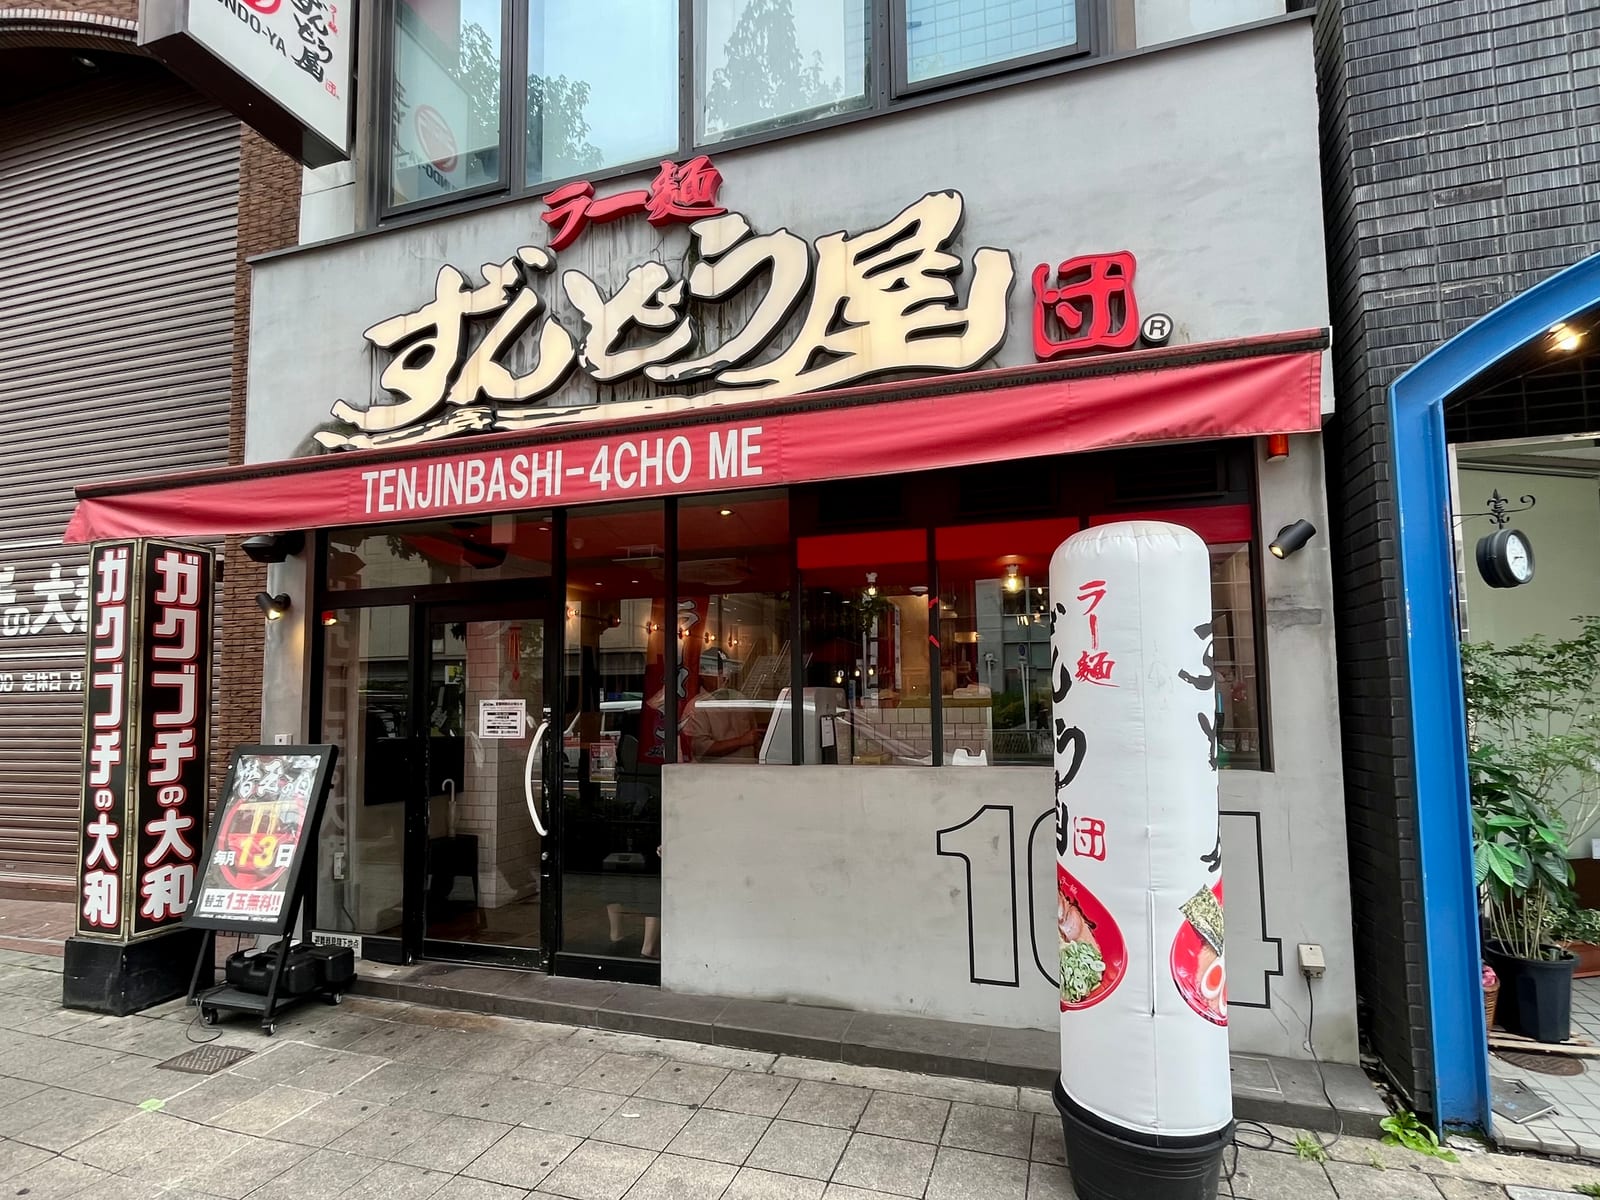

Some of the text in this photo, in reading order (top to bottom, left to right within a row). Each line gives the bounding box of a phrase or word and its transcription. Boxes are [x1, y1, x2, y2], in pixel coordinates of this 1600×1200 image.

[540, 155, 728, 253] ラー麺
[325, 189, 1015, 440] ずんどう屋
[1032, 249, 1141, 362] 団
[362, 426, 763, 513] TENJINBASHI-4CHO ME
[1074, 579, 1120, 688] ラー麺
[1073, 816, 1106, 861] 団
